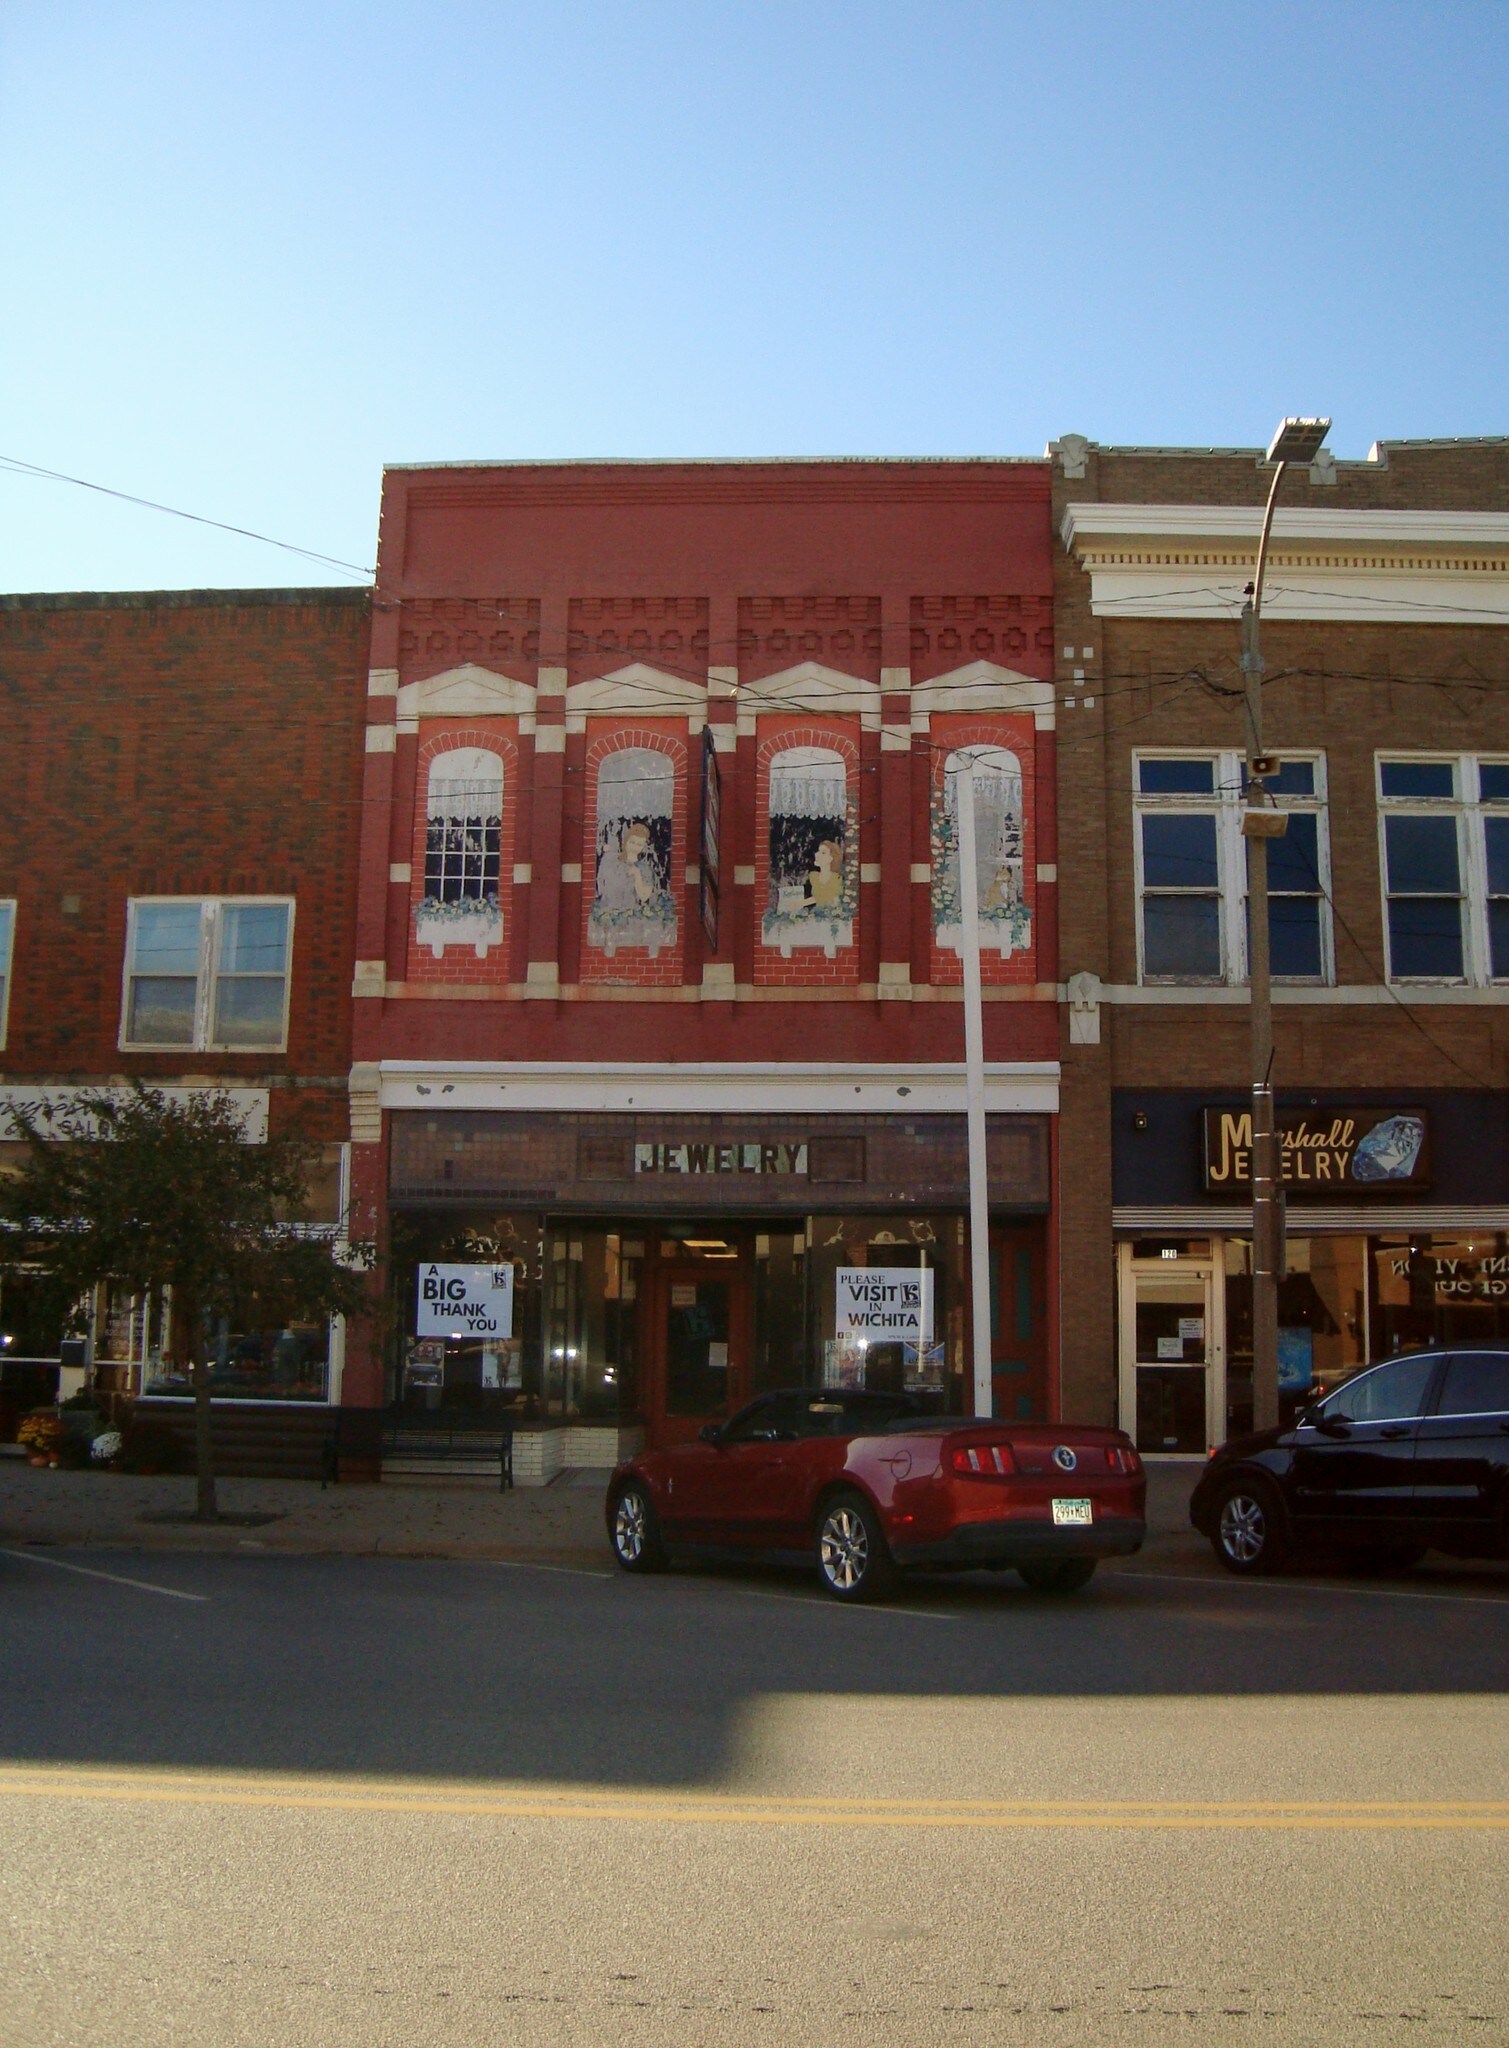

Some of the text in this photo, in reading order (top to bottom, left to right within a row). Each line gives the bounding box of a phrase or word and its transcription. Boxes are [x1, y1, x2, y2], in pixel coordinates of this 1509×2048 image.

[1221, 1113, 1354, 1148] Mshall
[641, 1144, 801, 1173] JEWELRY
[1210, 1151, 1349, 1180] JEELRY
[428, 1265, 439, 1276] A
[841, 1275, 885, 1285] PLEASE
[423, 1278, 466, 1300] BIG
[849, 1285, 898, 1301] VISIT
[432, 1303, 486, 1317] THANK
[869, 1302, 882, 1311] IN
[467, 1319, 497, 1331] YOU
[848, 1312, 919, 1327] WICHITA
